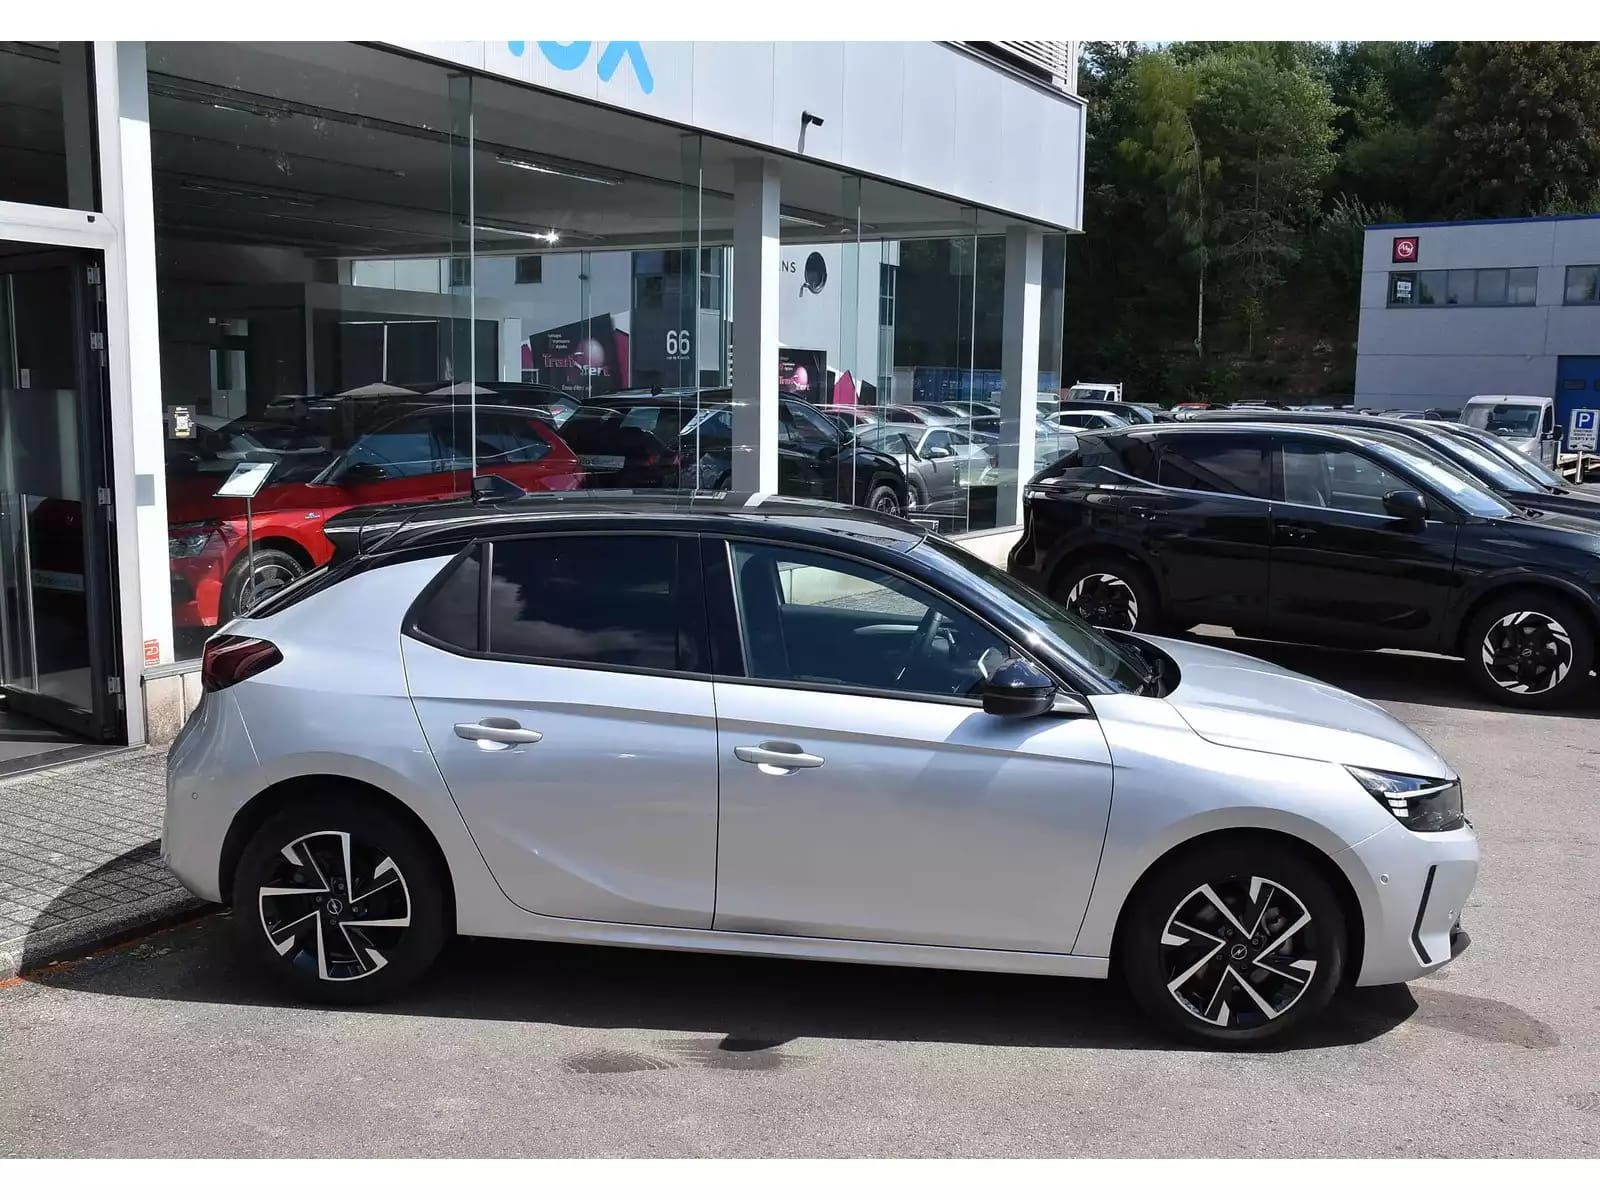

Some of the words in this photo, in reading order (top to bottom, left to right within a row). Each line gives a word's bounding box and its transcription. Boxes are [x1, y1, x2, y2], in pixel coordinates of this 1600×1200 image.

[779, 260, 796, 273] NS
[666, 329, 690, 355] 66
[1578, 412, 1591, 428] P
